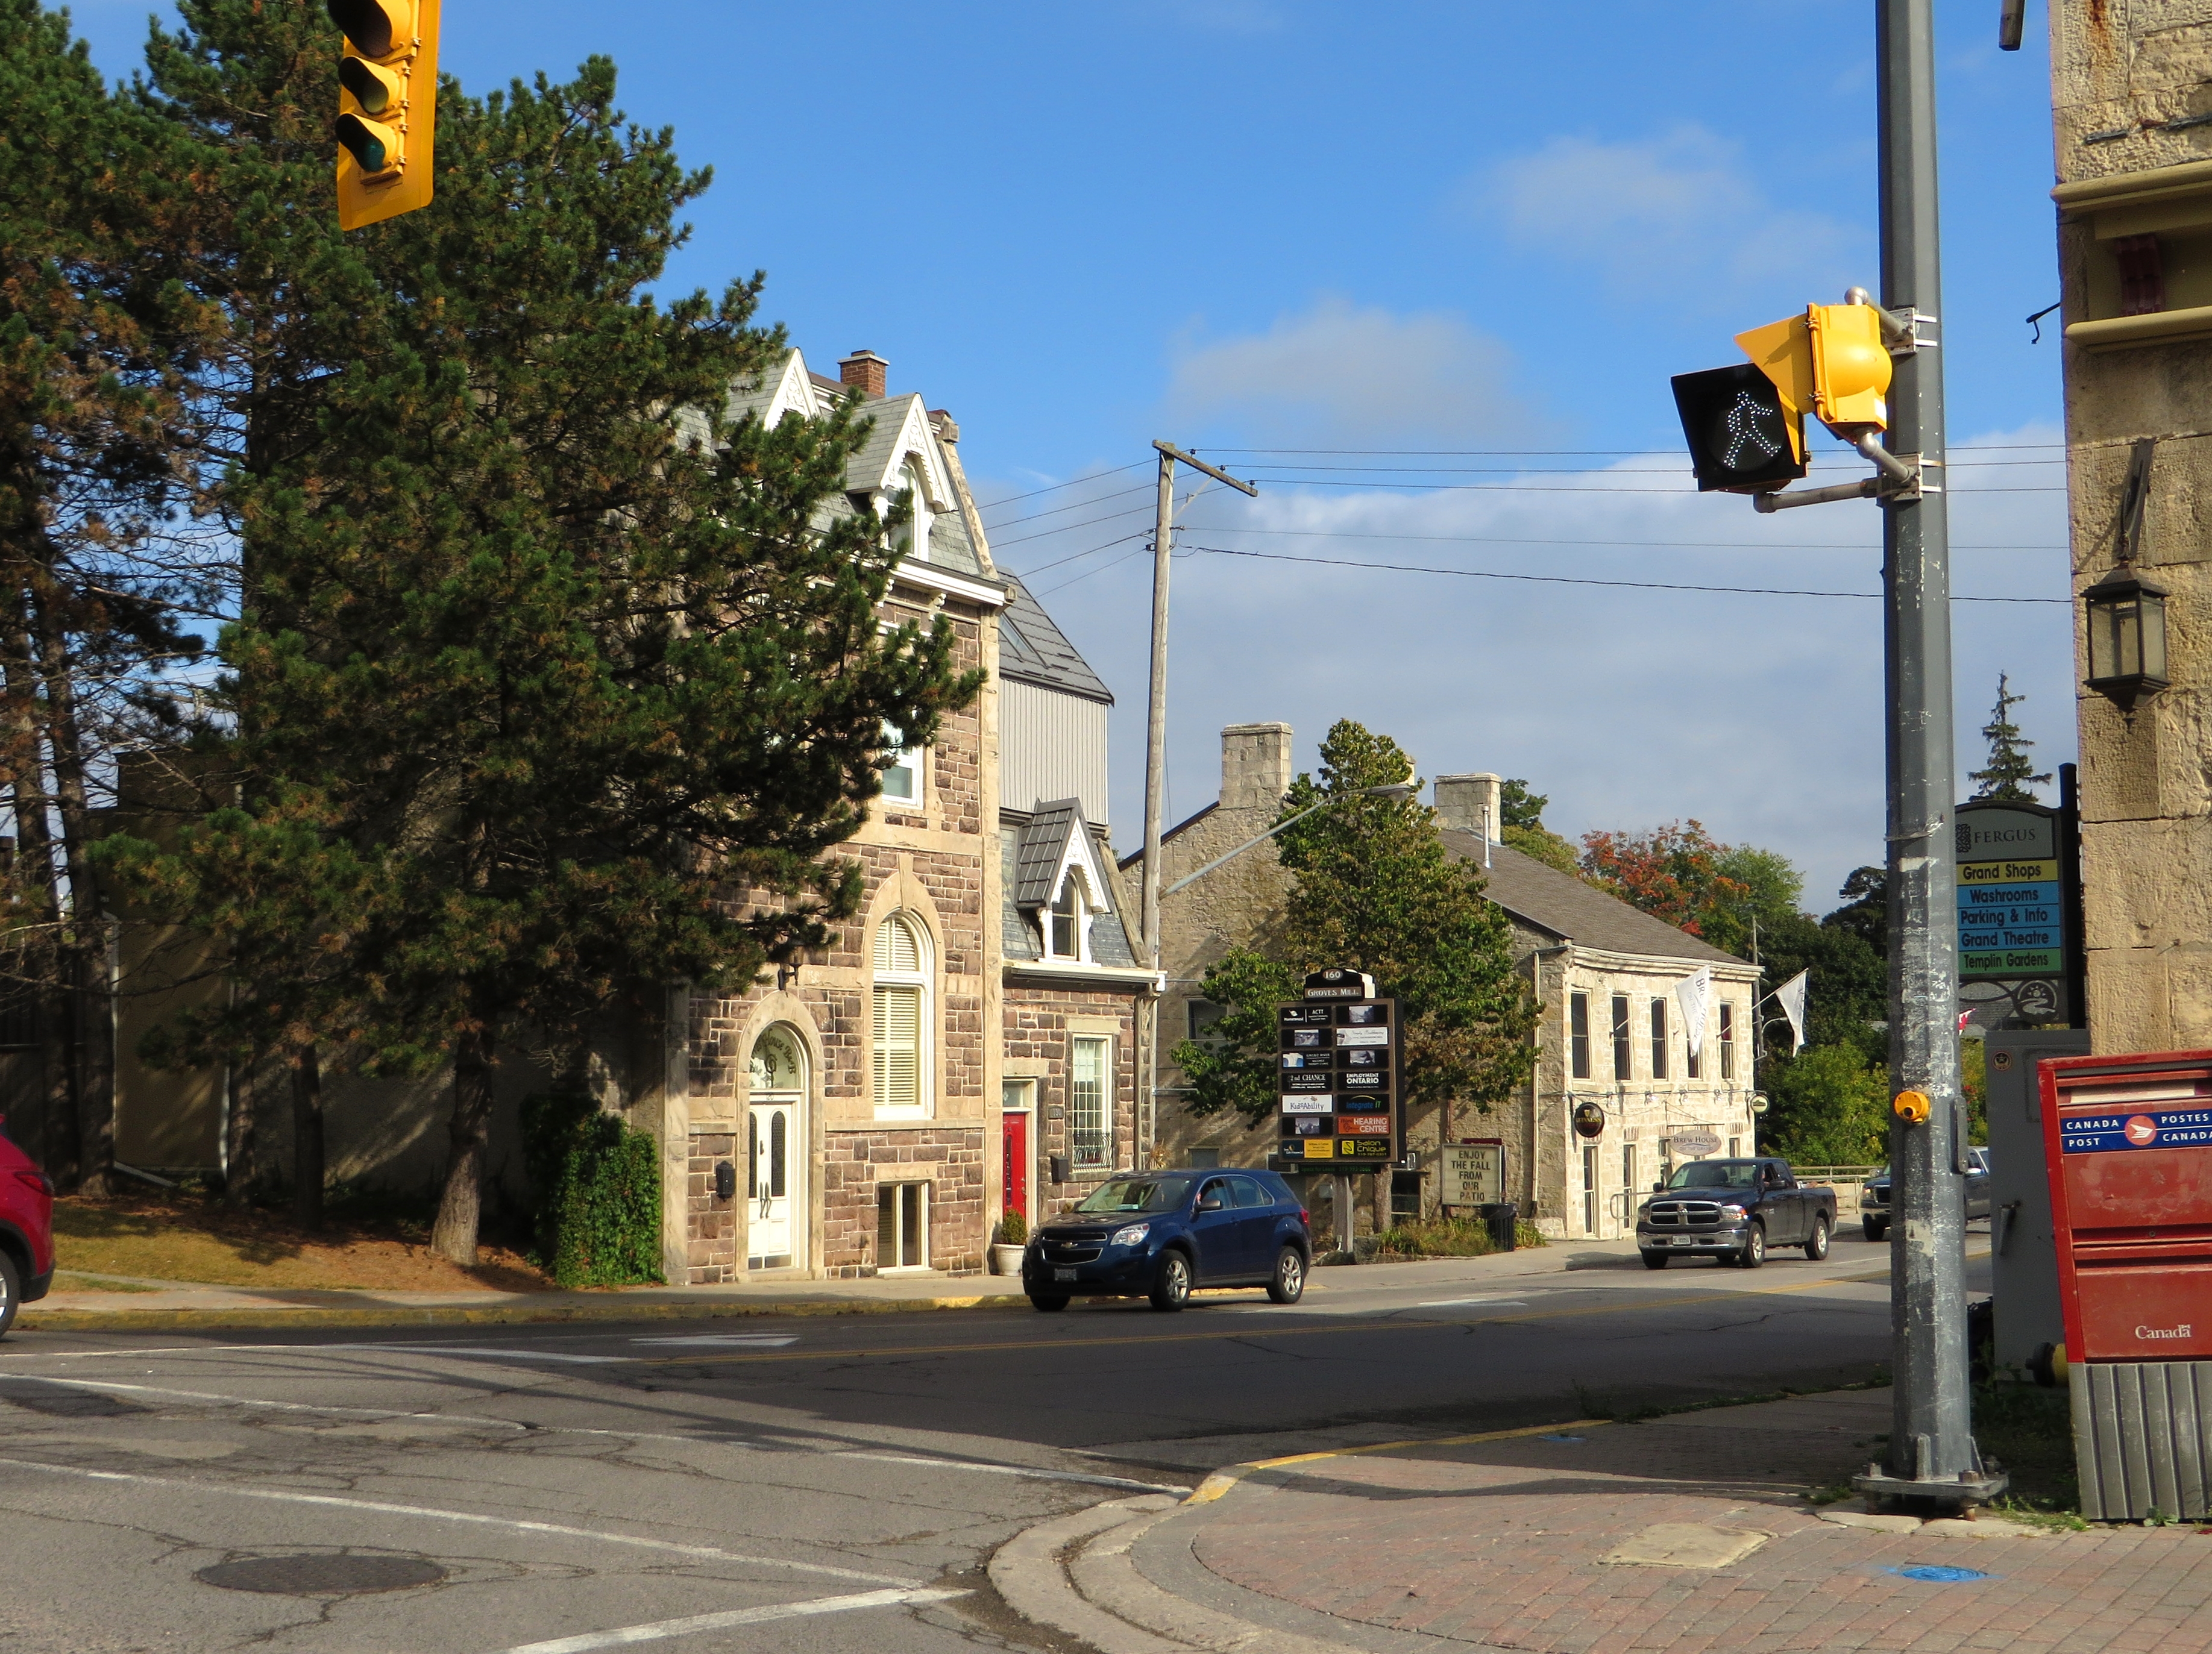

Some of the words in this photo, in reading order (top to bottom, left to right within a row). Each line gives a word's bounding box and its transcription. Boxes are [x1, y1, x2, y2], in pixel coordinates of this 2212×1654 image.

[1974, 829, 2035, 844] FERGUS
[1963, 864, 1999, 880] Grand
[2005, 863, 2041, 880] Shops
[1970, 888, 2038, 903] Washrooms
[1961, 909, 2005, 927] Parking
[2011, 908, 2019, 923] &
[2025, 906, 2048, 923] Info
[1961, 933, 1998, 947] Grand
[2003, 931, 2049, 946] Theatre
[1964, 954, 2002, 971] Templin
[2006, 952, 2048, 967] Gardens
[1290, 1101, 1324, 1111] KidsAbility
[2066, 1118, 2119, 1130] CANADA
[2161, 1113, 2208, 1124] POSTES
[2069, 1137, 2100, 1147] POST
[1459, 1150, 1486, 1159] ENJOY
[1451, 1161, 1467, 1169] THE
[1471, 1161, 1491, 1170] FALL
[1459, 1171, 1483, 1180] FROM
[1463, 1182, 1479, 1190] OUR
[1460, 1192, 1485, 1201] PATIO
[2135, 1324, 2191, 1339] Canada
